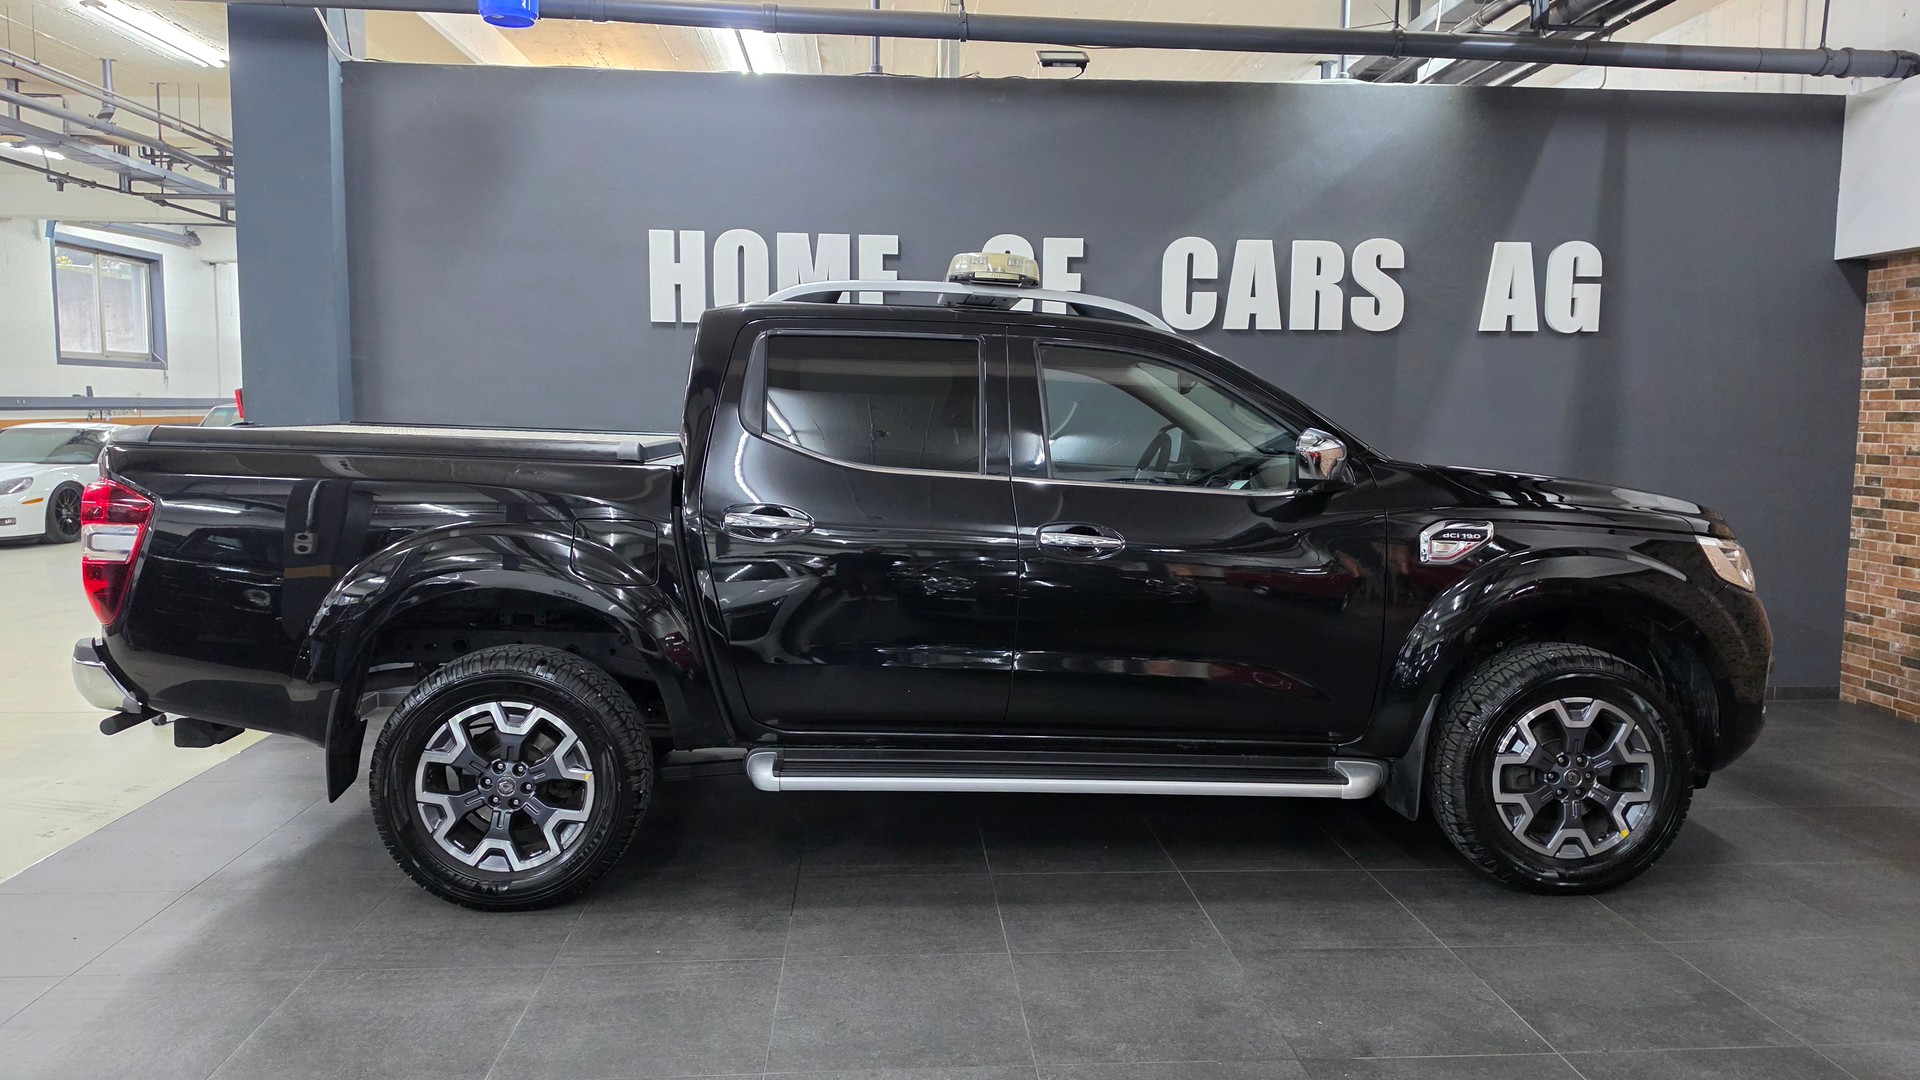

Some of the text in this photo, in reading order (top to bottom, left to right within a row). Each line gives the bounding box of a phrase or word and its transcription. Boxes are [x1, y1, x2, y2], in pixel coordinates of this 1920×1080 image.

[649, 229, 899, 322] HOME
[1161, 236, 1405, 331] CARS
[1478, 240, 1603, 333] AG
